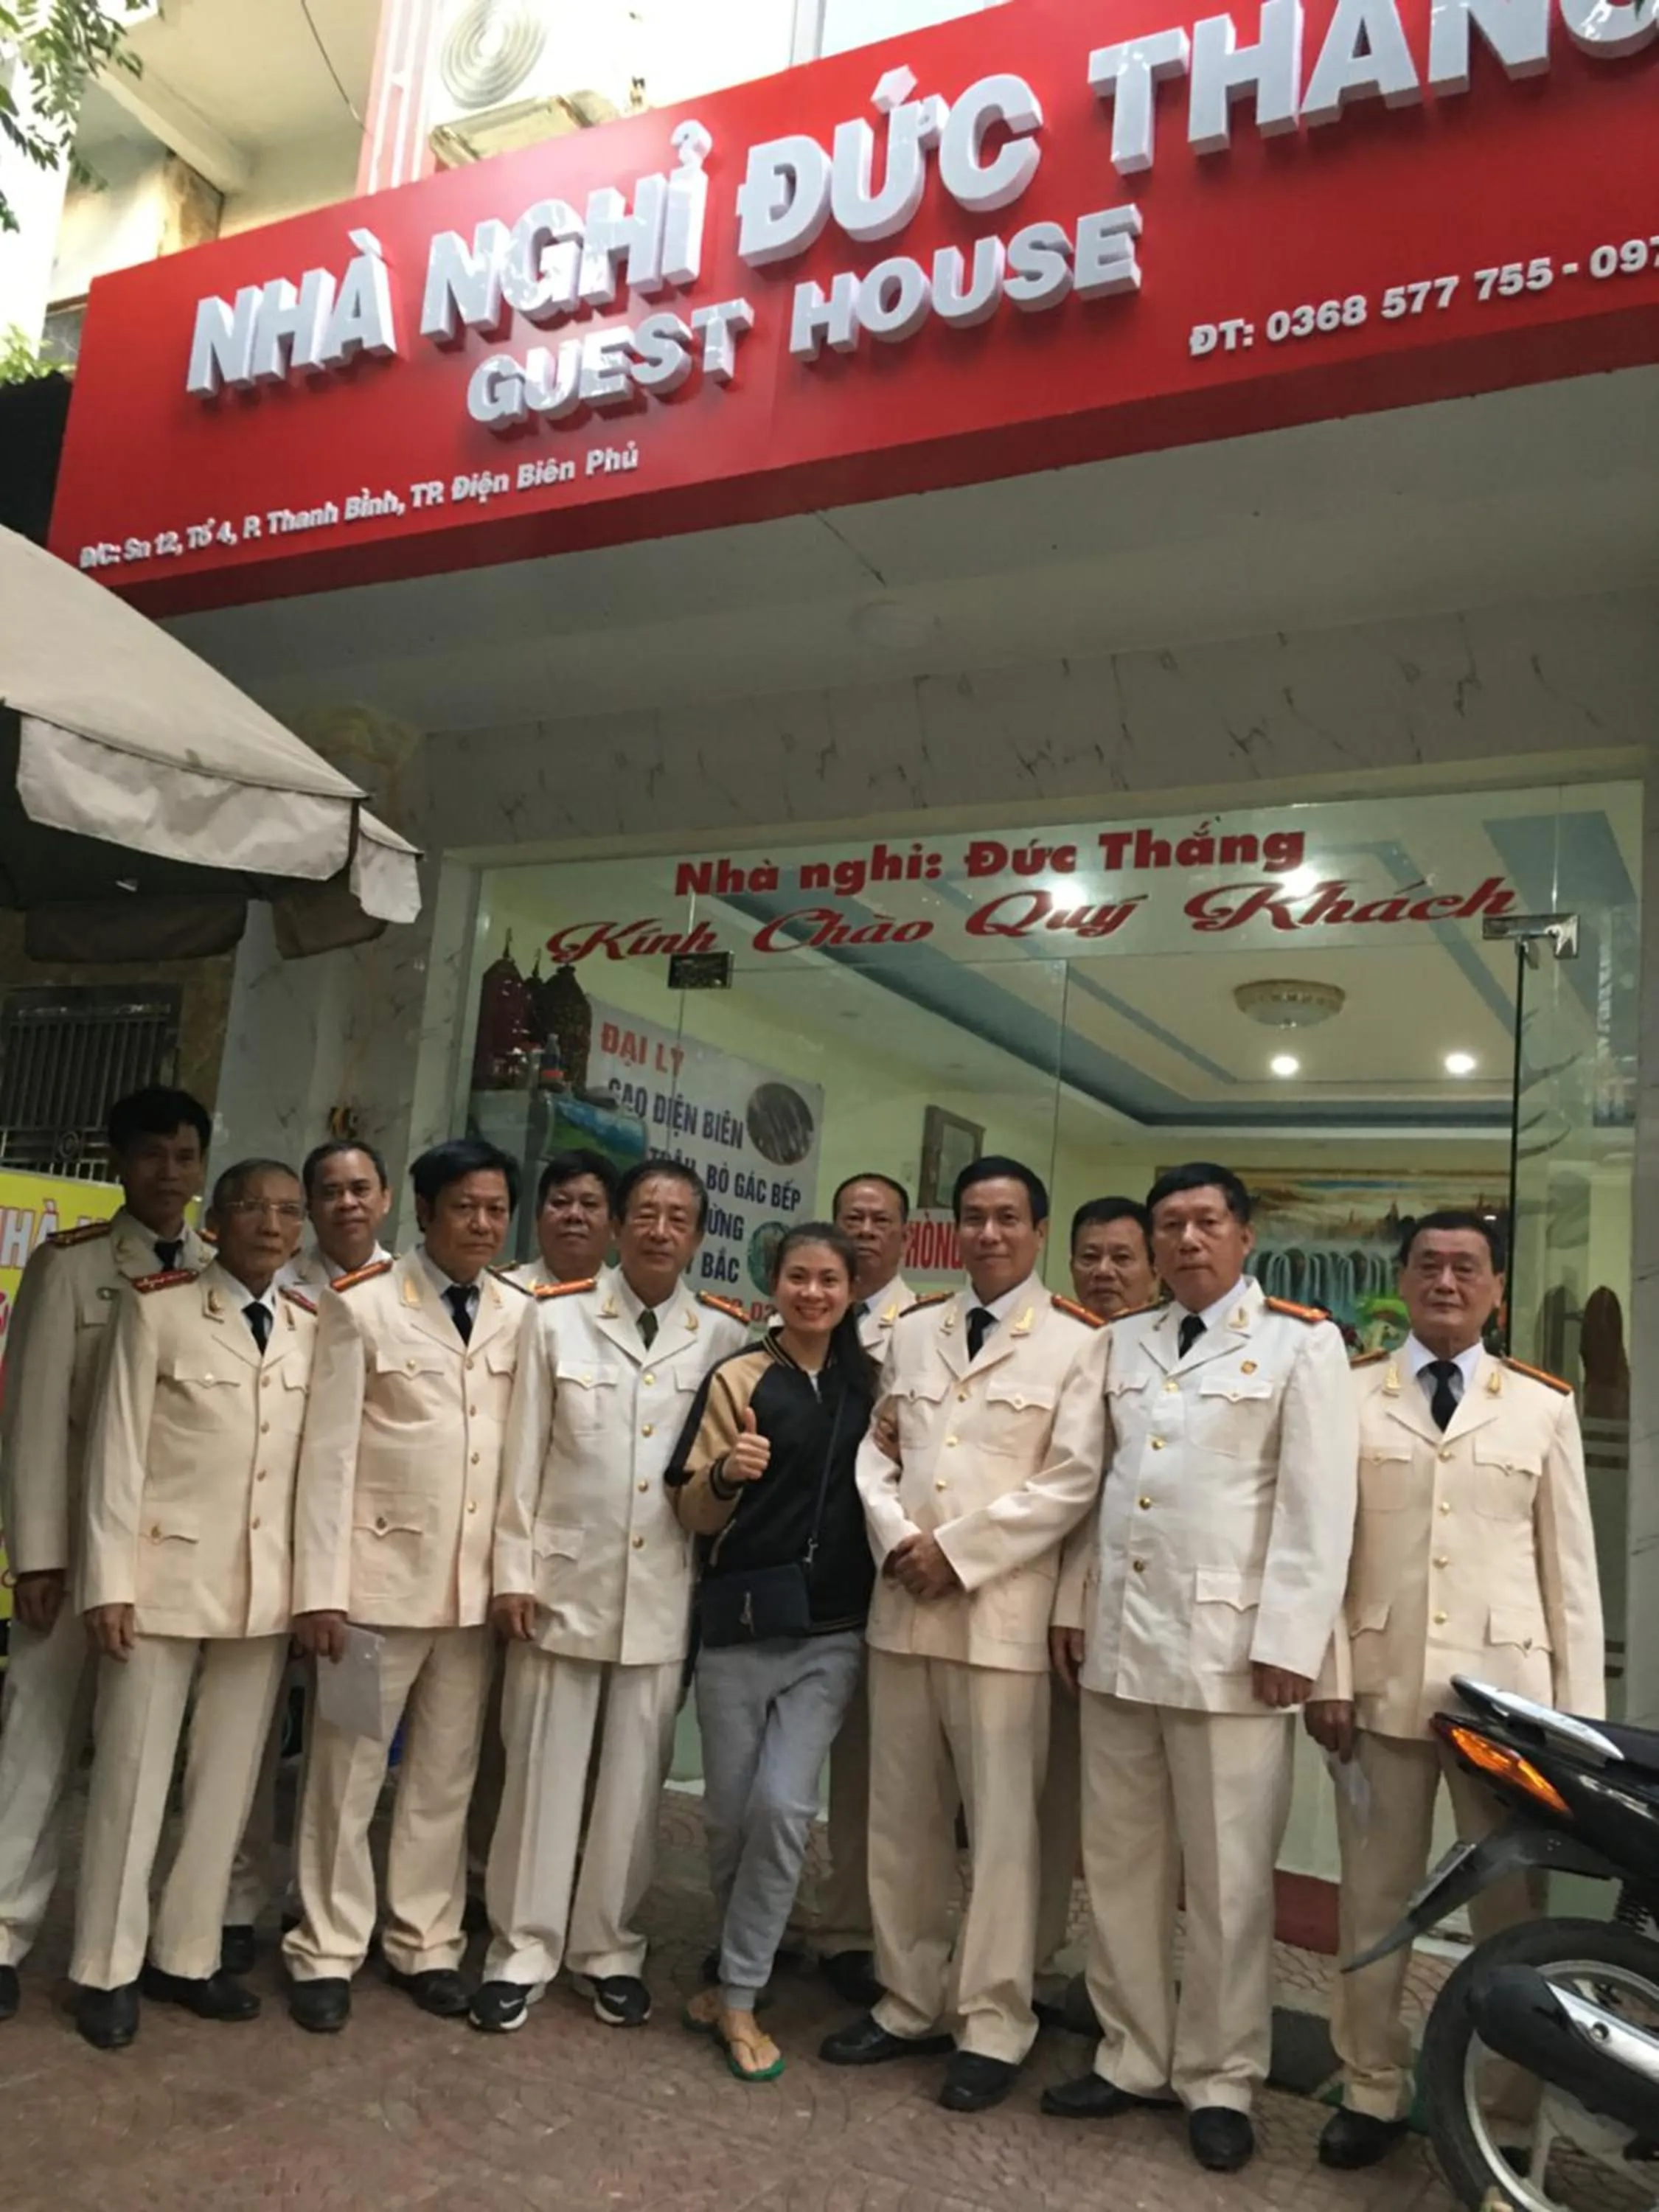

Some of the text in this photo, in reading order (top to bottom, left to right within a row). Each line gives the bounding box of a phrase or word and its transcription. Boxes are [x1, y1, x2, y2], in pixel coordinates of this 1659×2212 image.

[187, 228, 397, 397] NHÀ
[420, 119, 713, 340] NGHỈ
[736, 65, 1043, 266] ĐỨC
[467, 203, 1143, 429] GUEST HOUSE
[1189, 319, 1253, 355] ĐT:
[1266, 295, 1366, 341] 0368
[1381, 276, 1459, 318] 577
[1475, 256, 1554, 300] 755
[217, 521, 237, 544] 4,
[243, 515, 261, 538] P.
[267, 501, 338, 534] Thanh
[411, 481, 444, 507] TP.
[452, 471, 509, 502] Điện
[518, 459, 575, 489] Biên
[585, 441, 639, 475] Phủ
[675, 859, 778, 896] Nhà
[964, 838, 1077, 877] Đức
[1099, 820, 1305, 873] Thắng
[546, 877, 1517, 963] Kính Chào Quý Khách
[600, 1021, 648, 1067] ĐẠI
[653, 1093, 698, 1138] ĐIỆN
[703, 1109, 744, 1150] BIÊN
[706, 1161, 801, 1211] BÒ GÁC BẾP
[701, 1246, 740, 1284] BẮC
